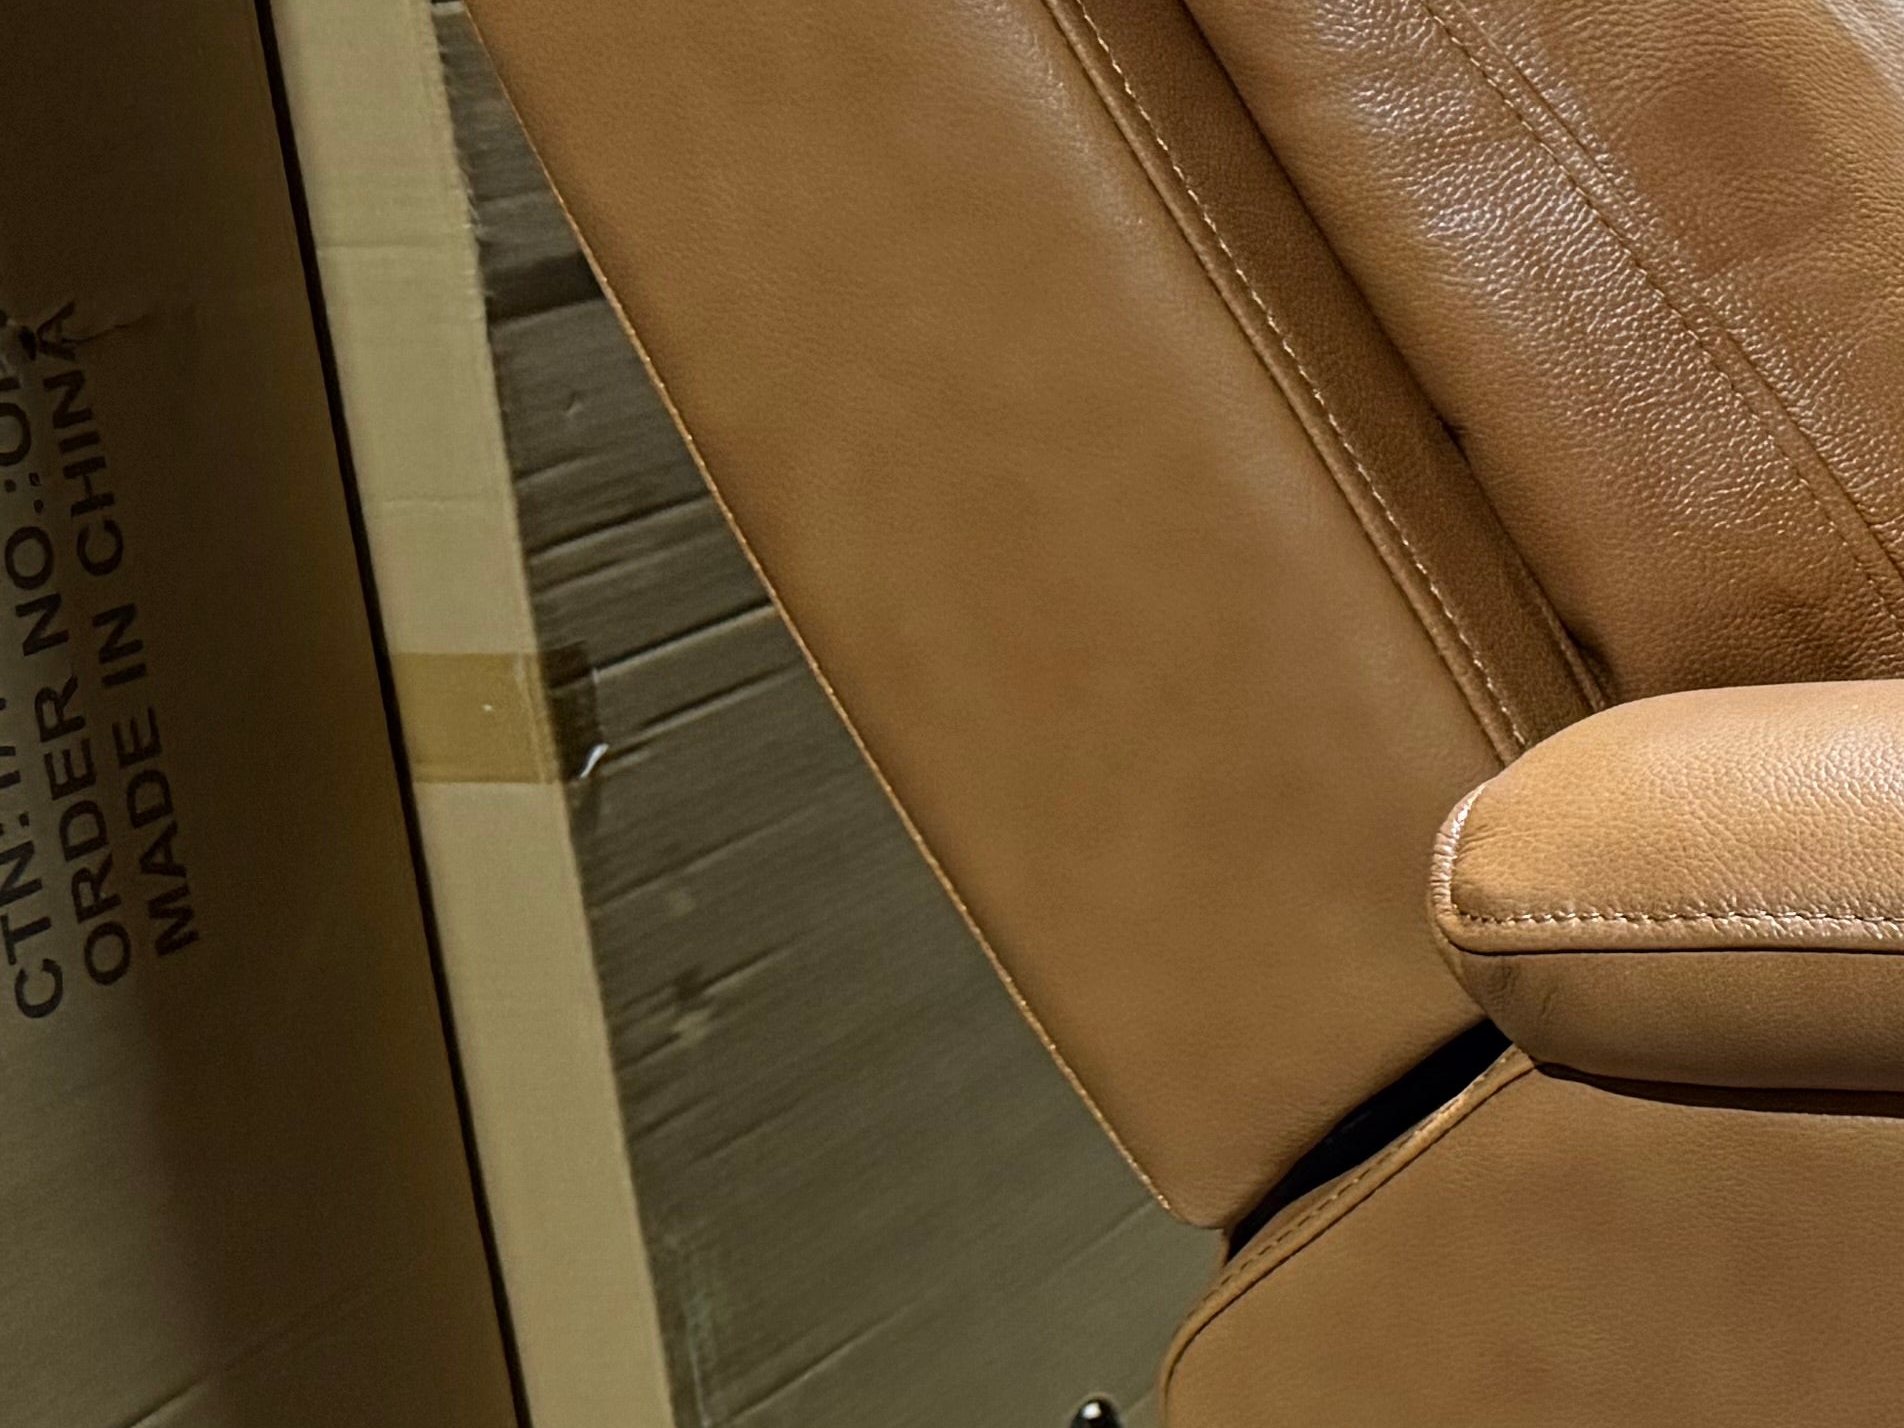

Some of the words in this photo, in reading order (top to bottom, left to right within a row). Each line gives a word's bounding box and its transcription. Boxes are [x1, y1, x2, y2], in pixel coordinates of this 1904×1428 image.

[37, 300, 124, 577] CHINA
[93, 602, 147, 690] IN
[34, 674, 131, 986] ORDER
[112, 706, 199, 956] MADE
